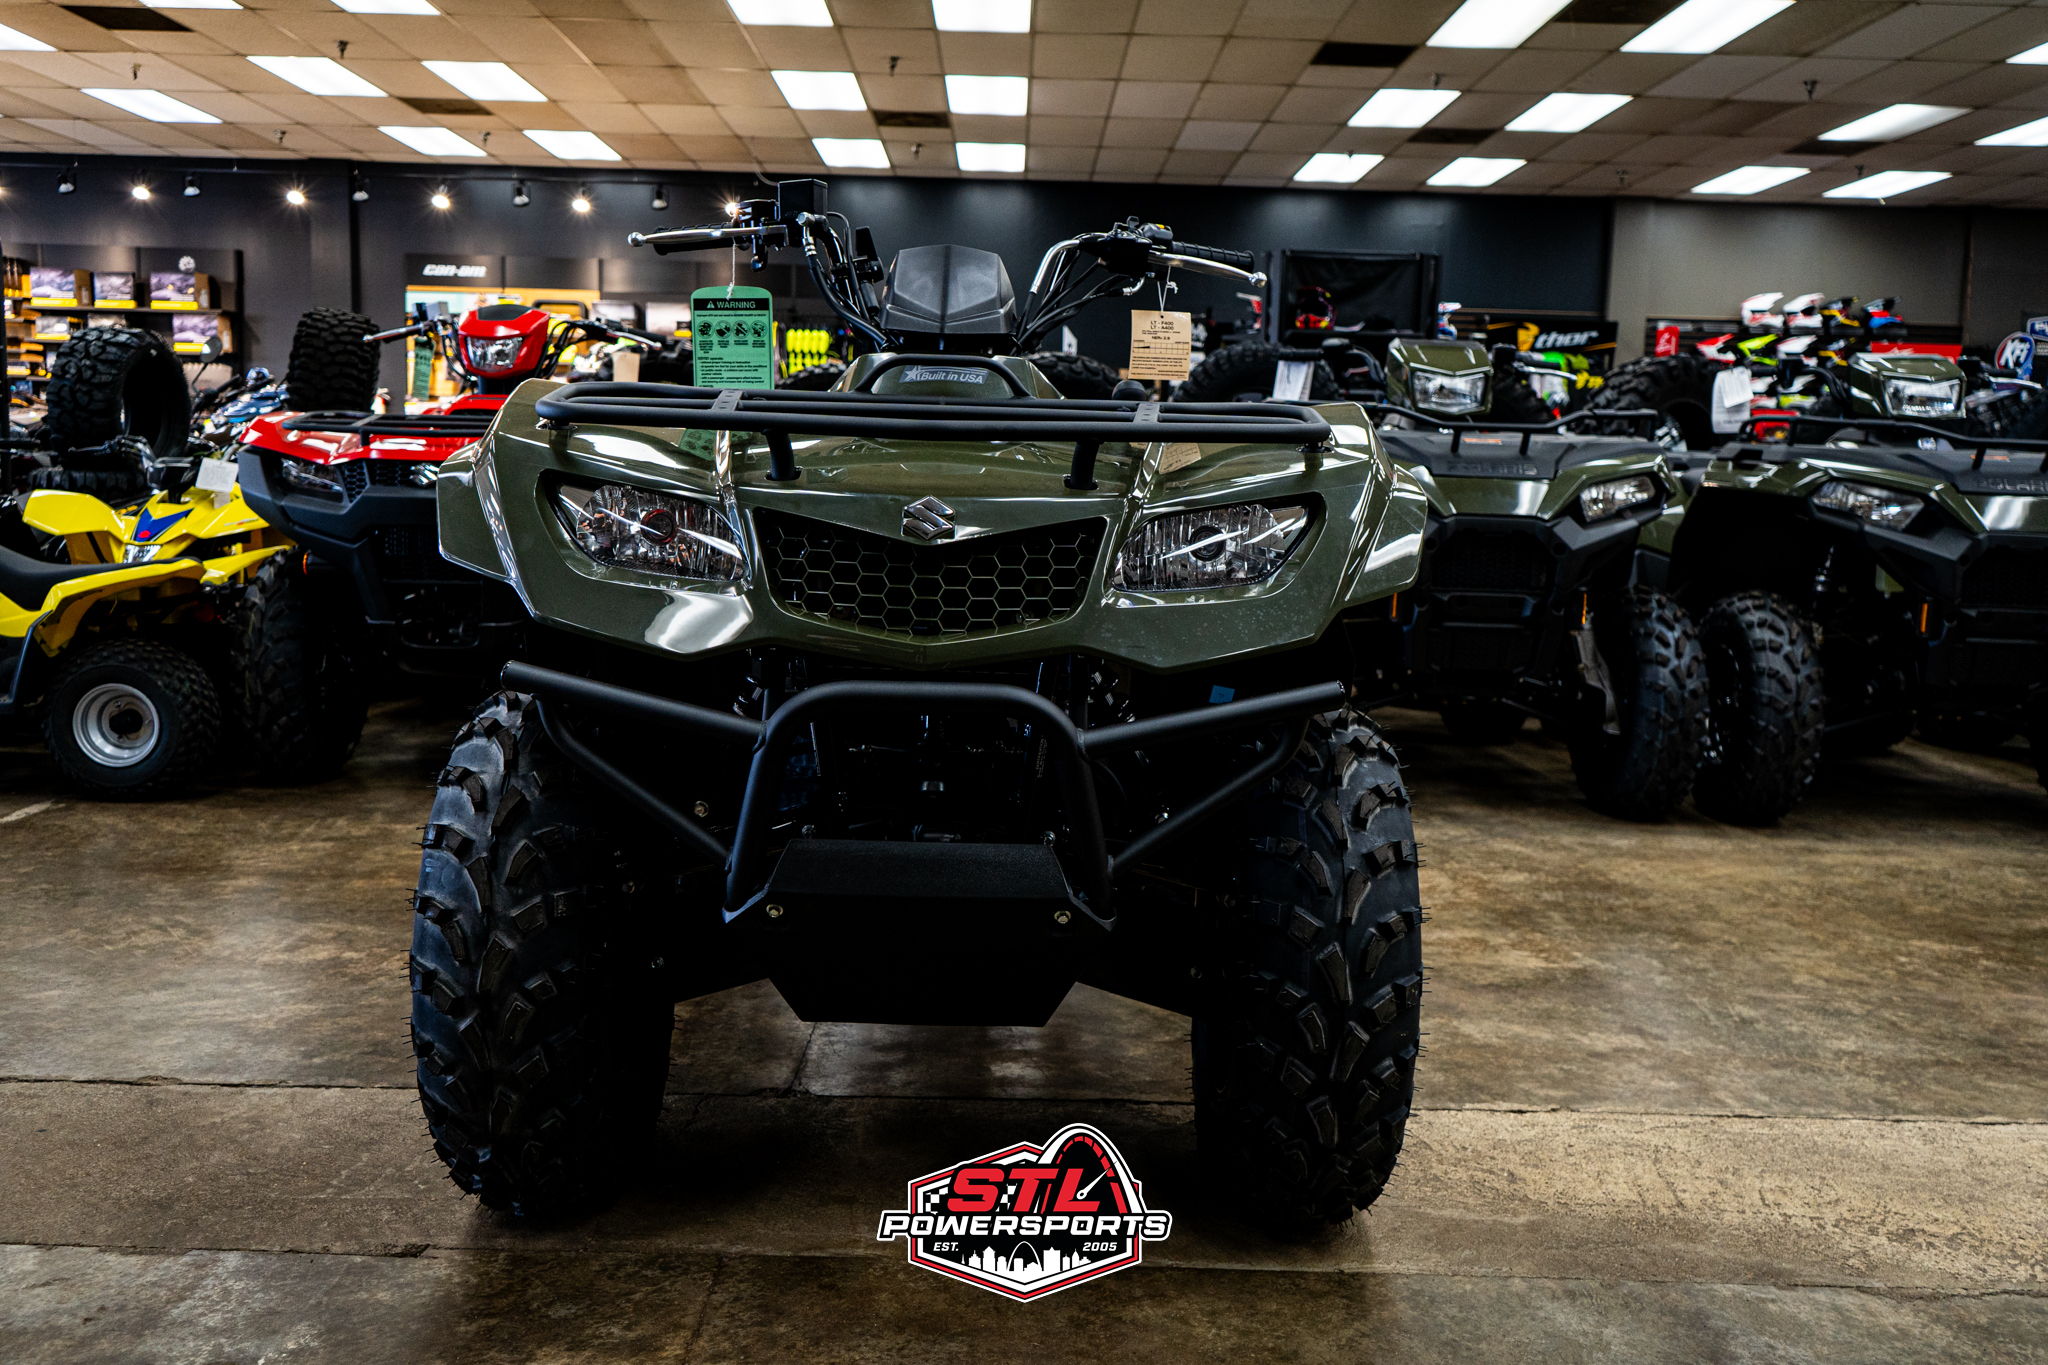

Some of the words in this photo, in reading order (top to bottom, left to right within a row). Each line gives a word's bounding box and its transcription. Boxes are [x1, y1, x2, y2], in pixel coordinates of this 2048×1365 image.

[716, 301, 756, 309] WARNING
[1533, 330, 1600, 349] thor
[920, 371, 946, 381] Built
[947, 372, 959, 381] in
[960, 373, 983, 384] USA
